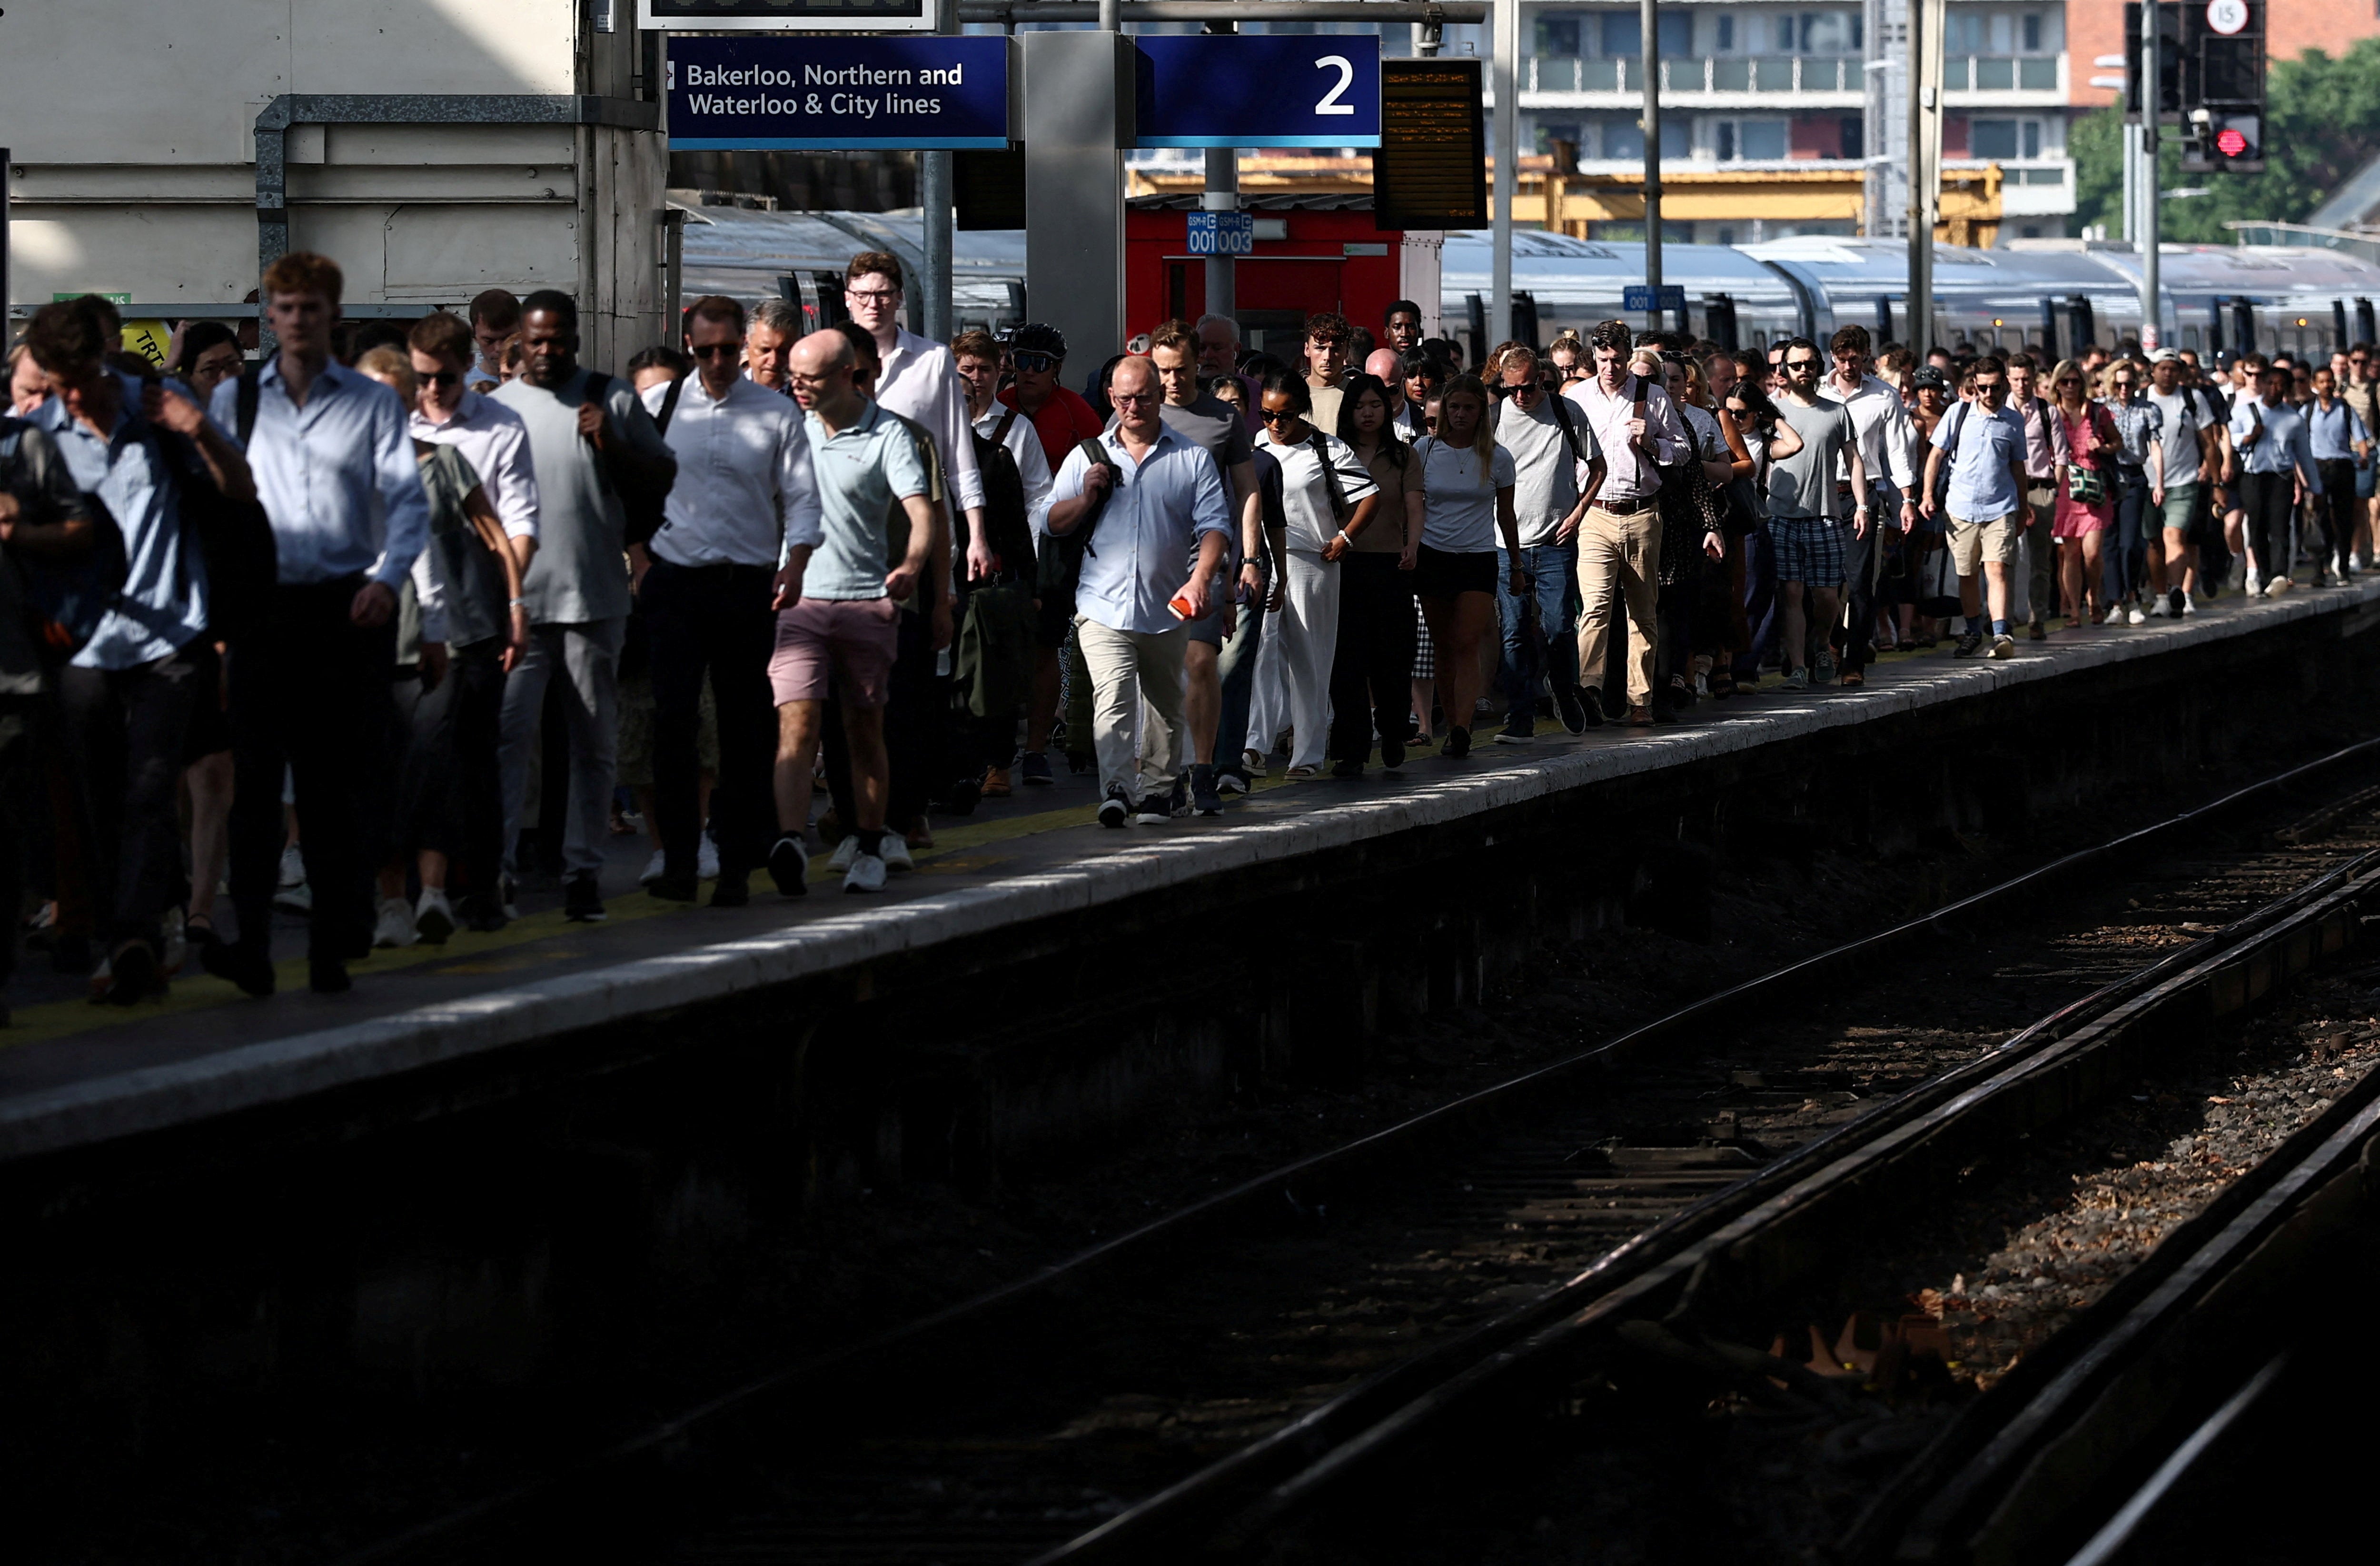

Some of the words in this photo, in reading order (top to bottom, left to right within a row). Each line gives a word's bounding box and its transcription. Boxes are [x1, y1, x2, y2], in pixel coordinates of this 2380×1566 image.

[2218, 5, 2236, 24] 15
[687, 64, 796, 88] Bakerloo,
[804, 63, 911, 86] Northern
[919, 63, 962, 85] and
[1314, 55, 1354, 115] 2
[688, 93, 797, 115] Waterloo
[804, 93, 823, 115] &
[830, 92, 879, 119] City
[886, 92, 941, 114] lines
[1188, 216, 1207, 227] GSM-R
[1219, 217, 1240, 227] GSM-R
[1190, 230, 1215, 252] 001
[1218, 230, 1253, 252] 003
[1629, 295, 1648, 309] 001
